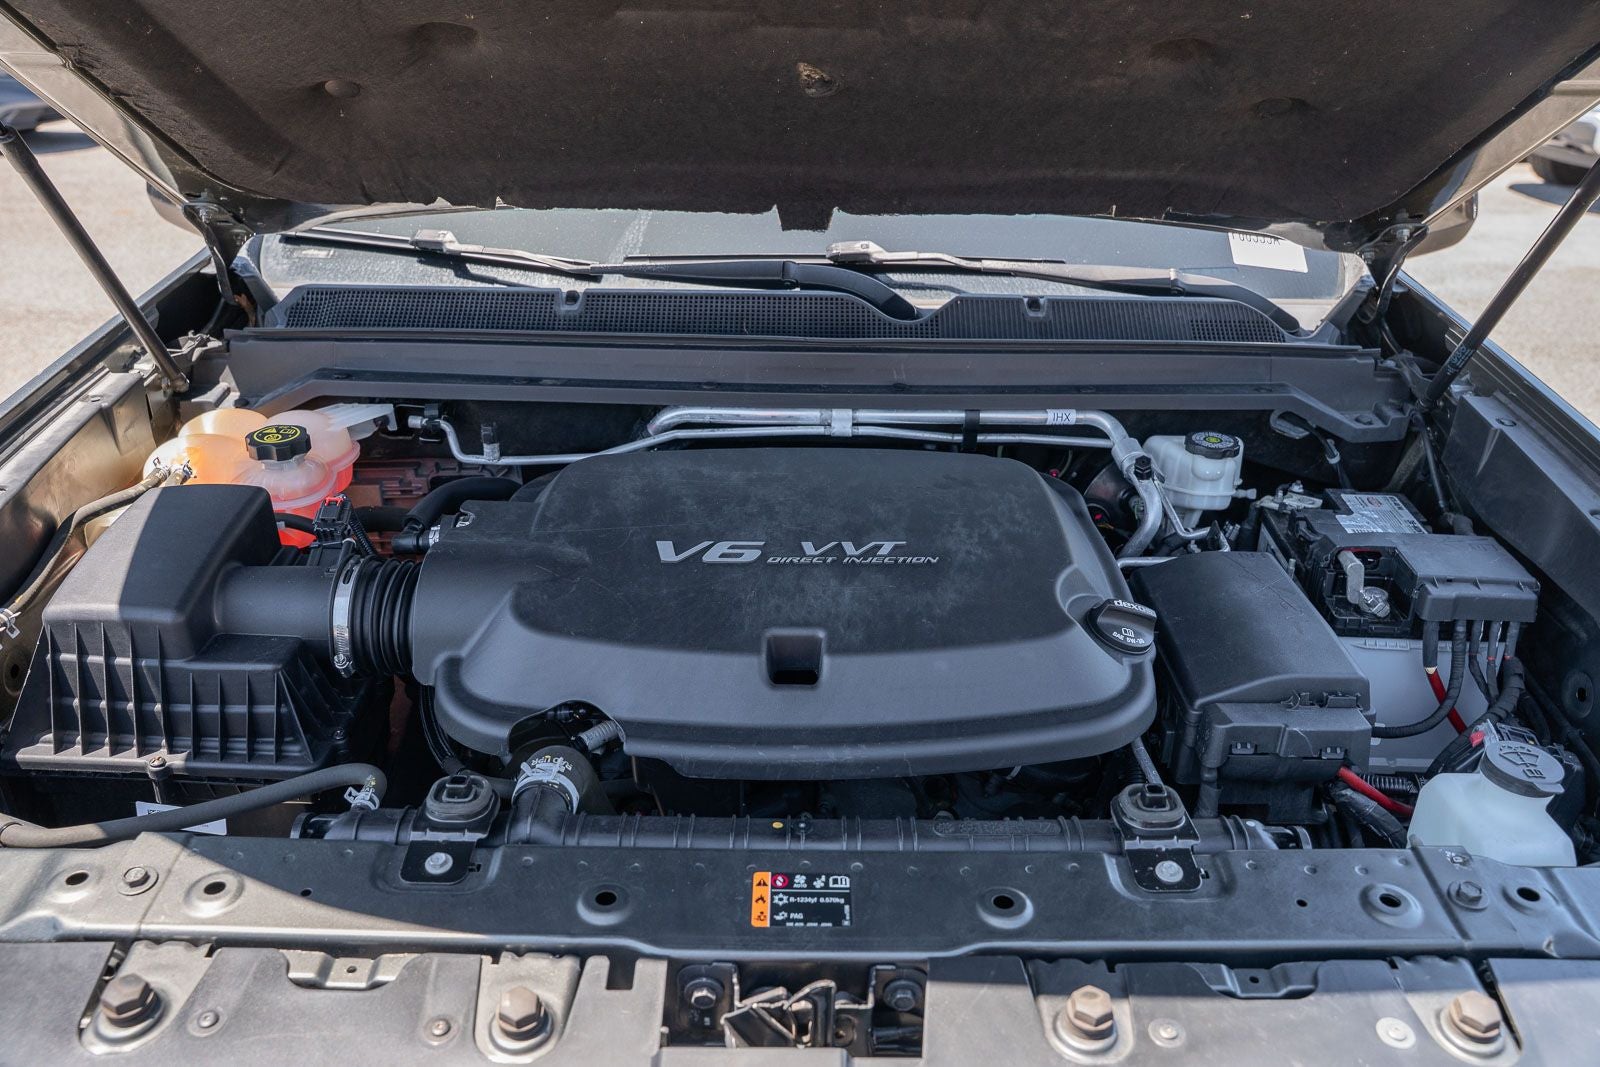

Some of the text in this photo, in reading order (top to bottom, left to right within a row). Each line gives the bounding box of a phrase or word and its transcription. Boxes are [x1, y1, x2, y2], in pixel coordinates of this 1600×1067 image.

[655, 540, 907, 564] V6 VVT
[766, 556, 940, 564] DIRECT INJECTION
